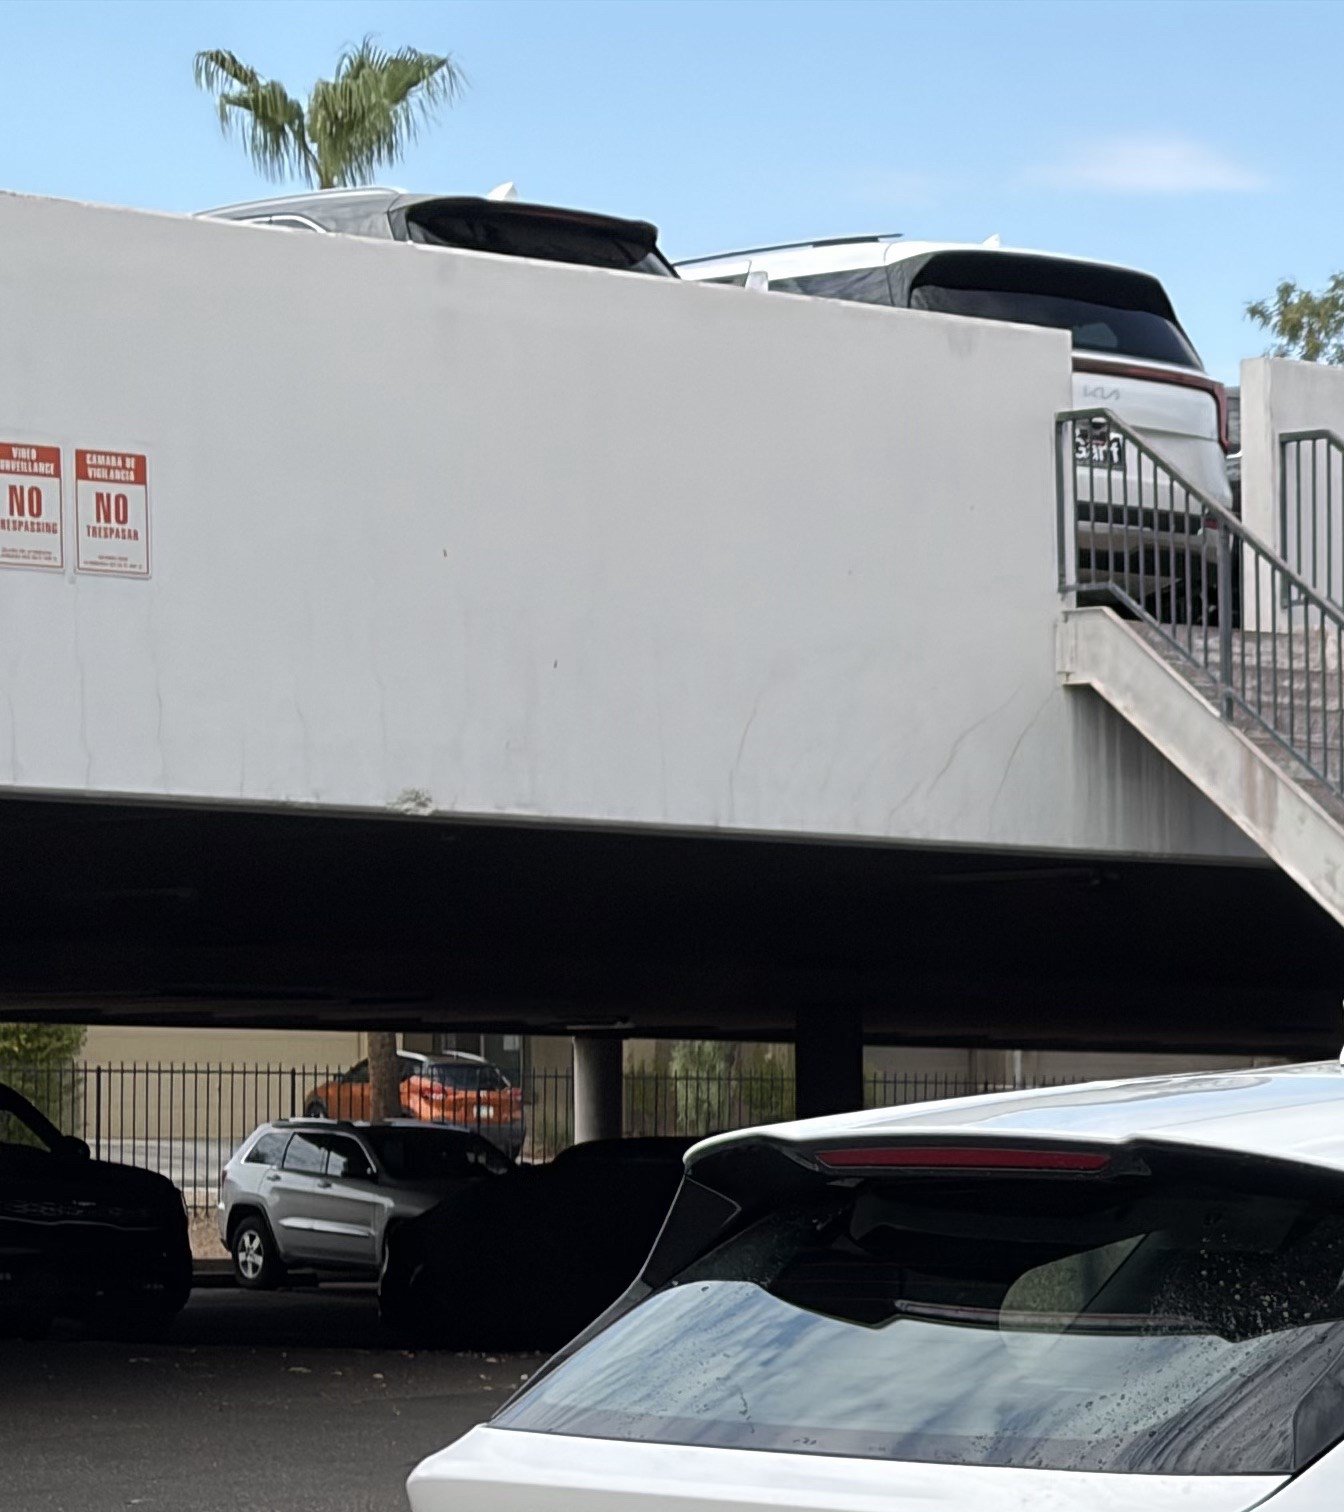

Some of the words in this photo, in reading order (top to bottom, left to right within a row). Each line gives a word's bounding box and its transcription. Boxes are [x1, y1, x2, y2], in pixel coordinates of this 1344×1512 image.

[12, 447, 36, 461] VIDEO
[0, 459, 54, 475] URVEILLANCE
[126, 457, 136, 469] DE
[88, 467, 135, 482] VIGILANCIA
[8, 485, 42, 518] NO
[95, 492, 128, 525] NO
[0, 519, 58, 535] RESPASSING
[87, 525, 139, 541] TRESPASAR
